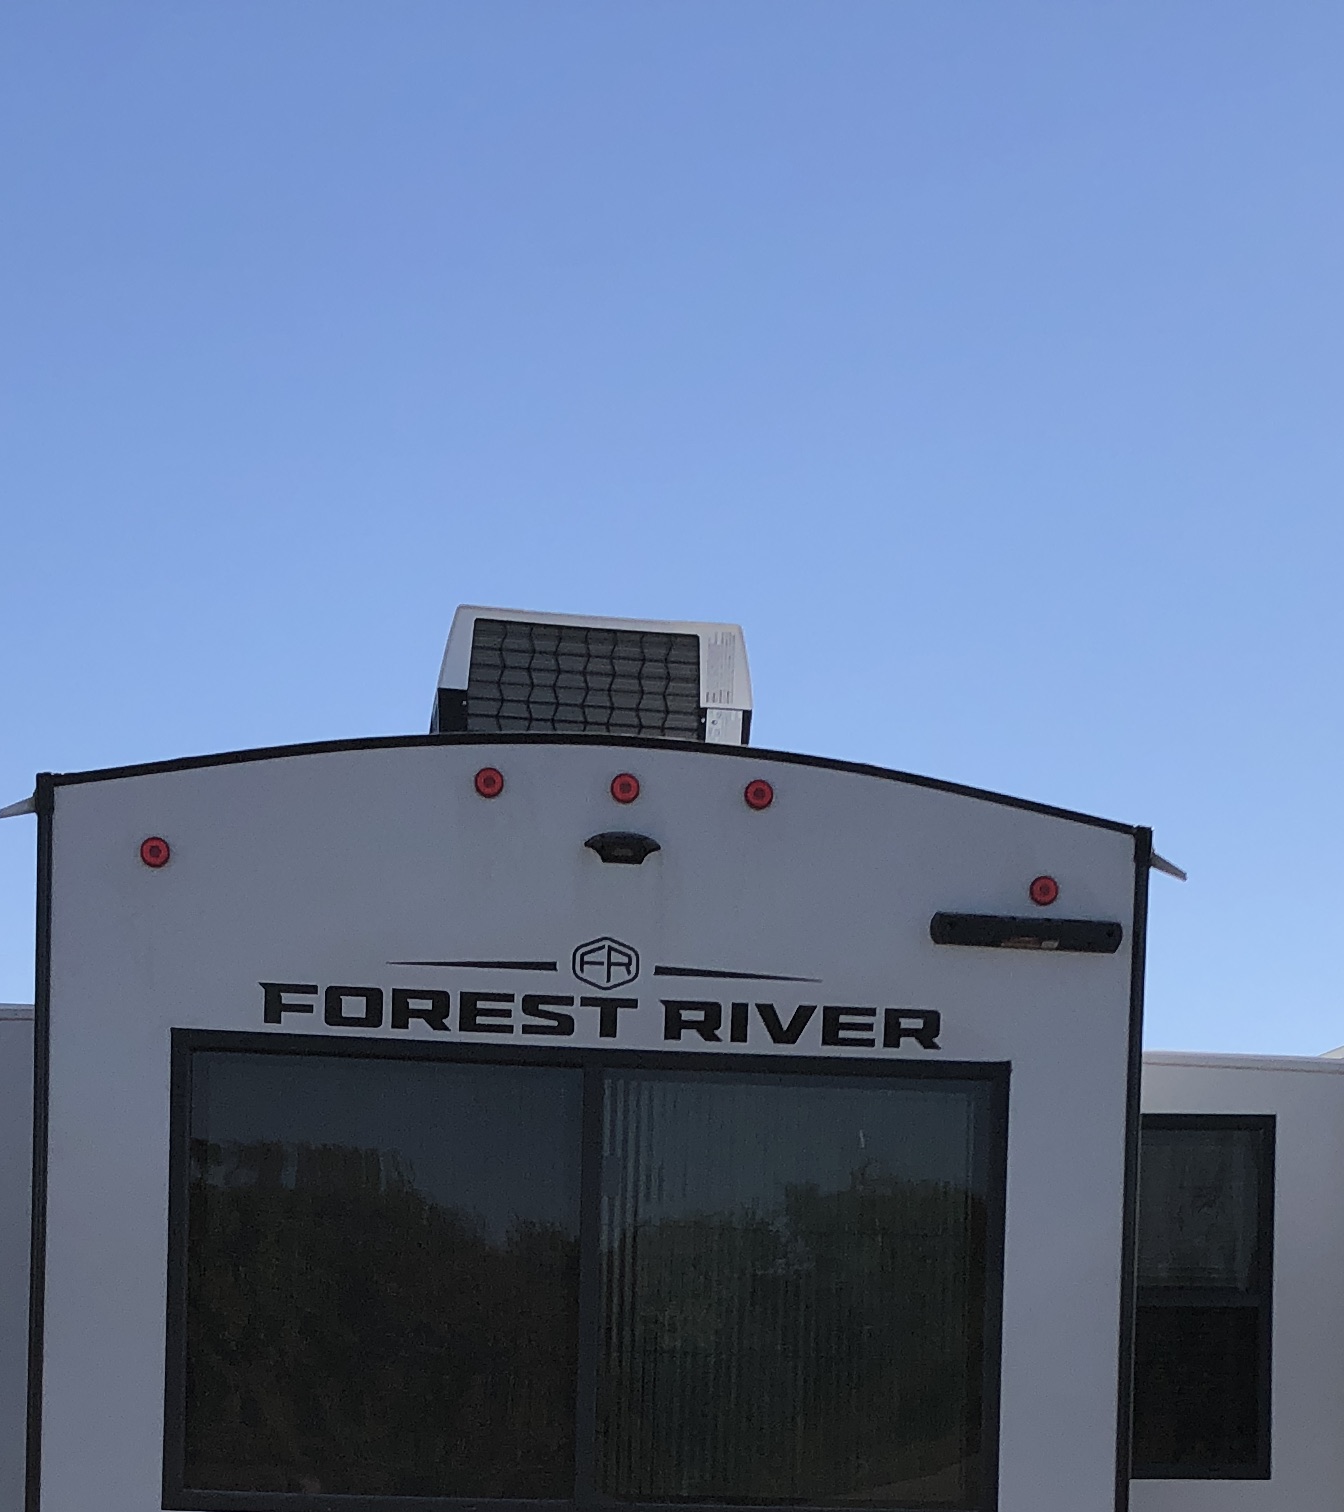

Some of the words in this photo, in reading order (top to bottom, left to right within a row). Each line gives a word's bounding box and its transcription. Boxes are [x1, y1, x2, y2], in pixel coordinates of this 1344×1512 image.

[578, 942, 634, 985] FR
[257, 981, 639, 1039] FOREST
[658, 999, 942, 1051] RIVER
